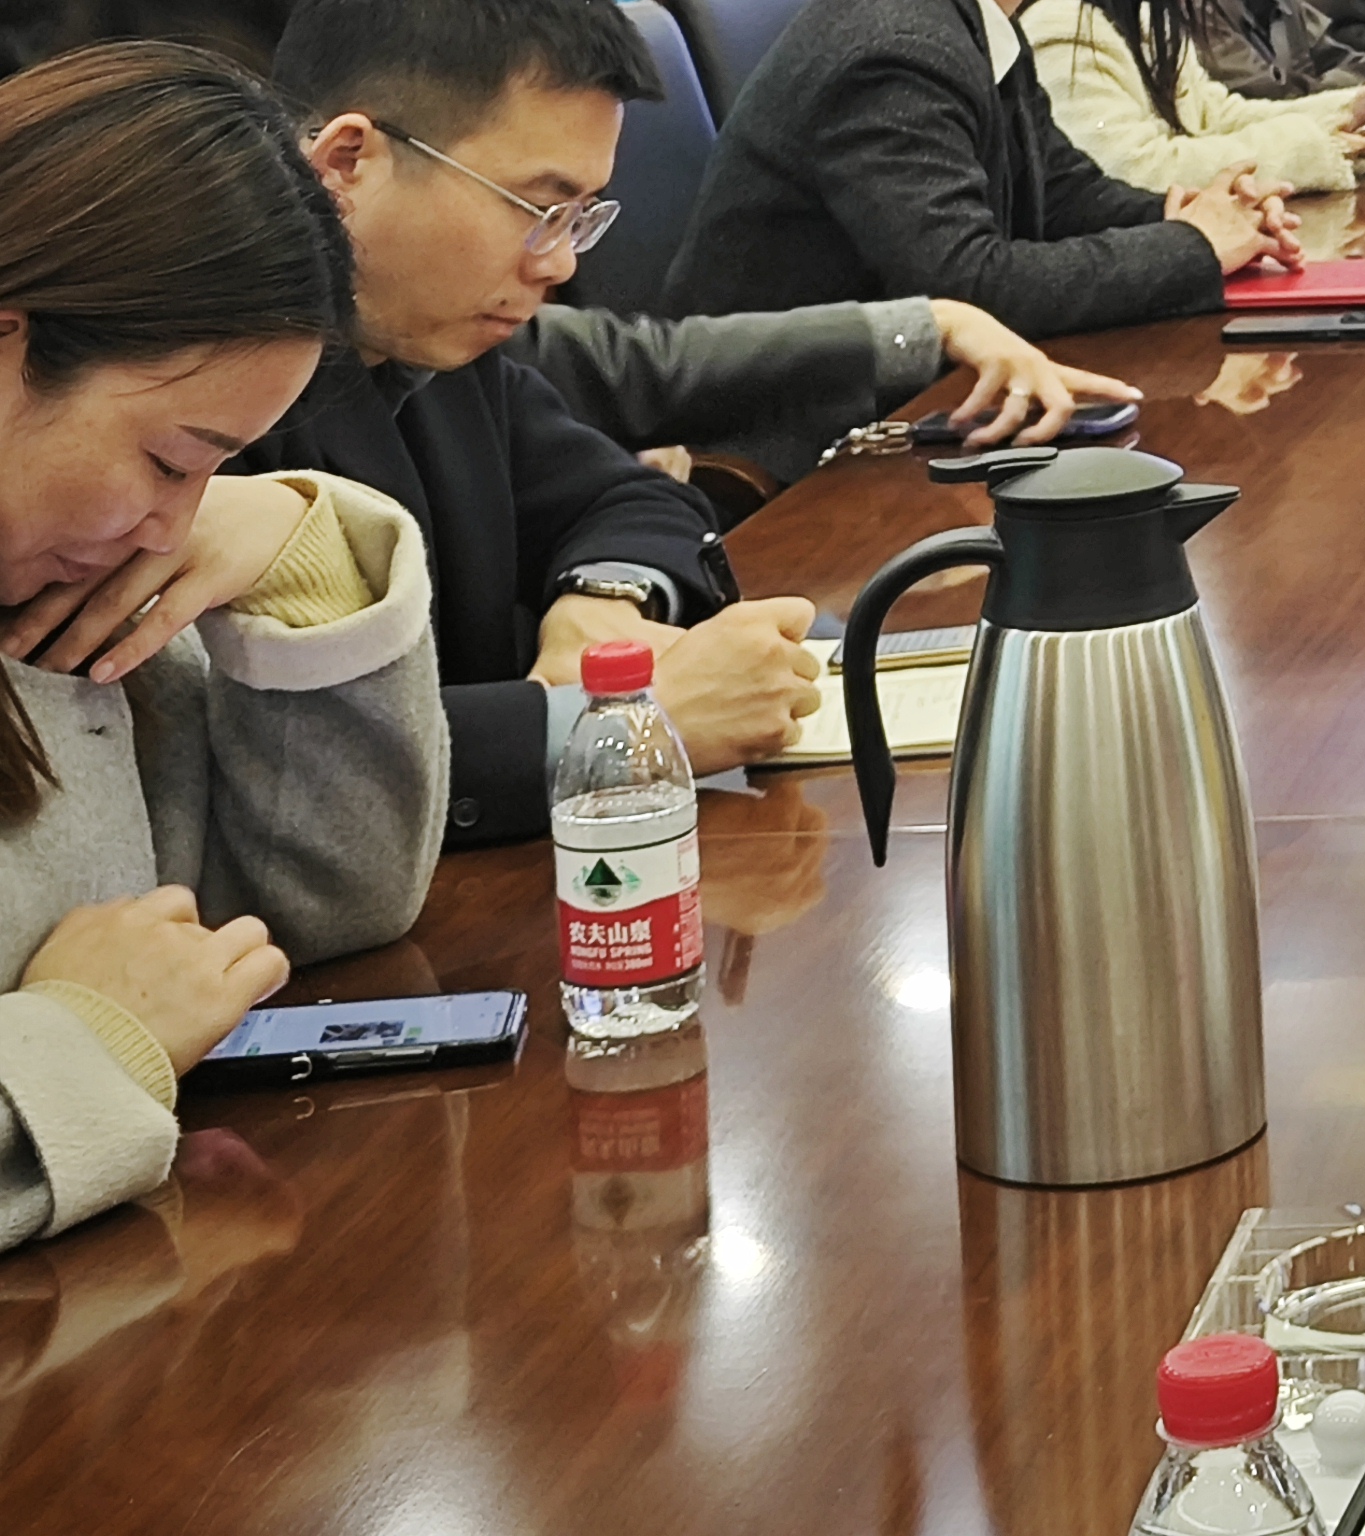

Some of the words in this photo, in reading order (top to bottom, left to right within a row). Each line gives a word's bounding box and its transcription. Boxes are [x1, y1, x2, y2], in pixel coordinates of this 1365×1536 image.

[569, 917, 652, 945] 农夫山泉
[610, 942, 652, 958] SPRING
